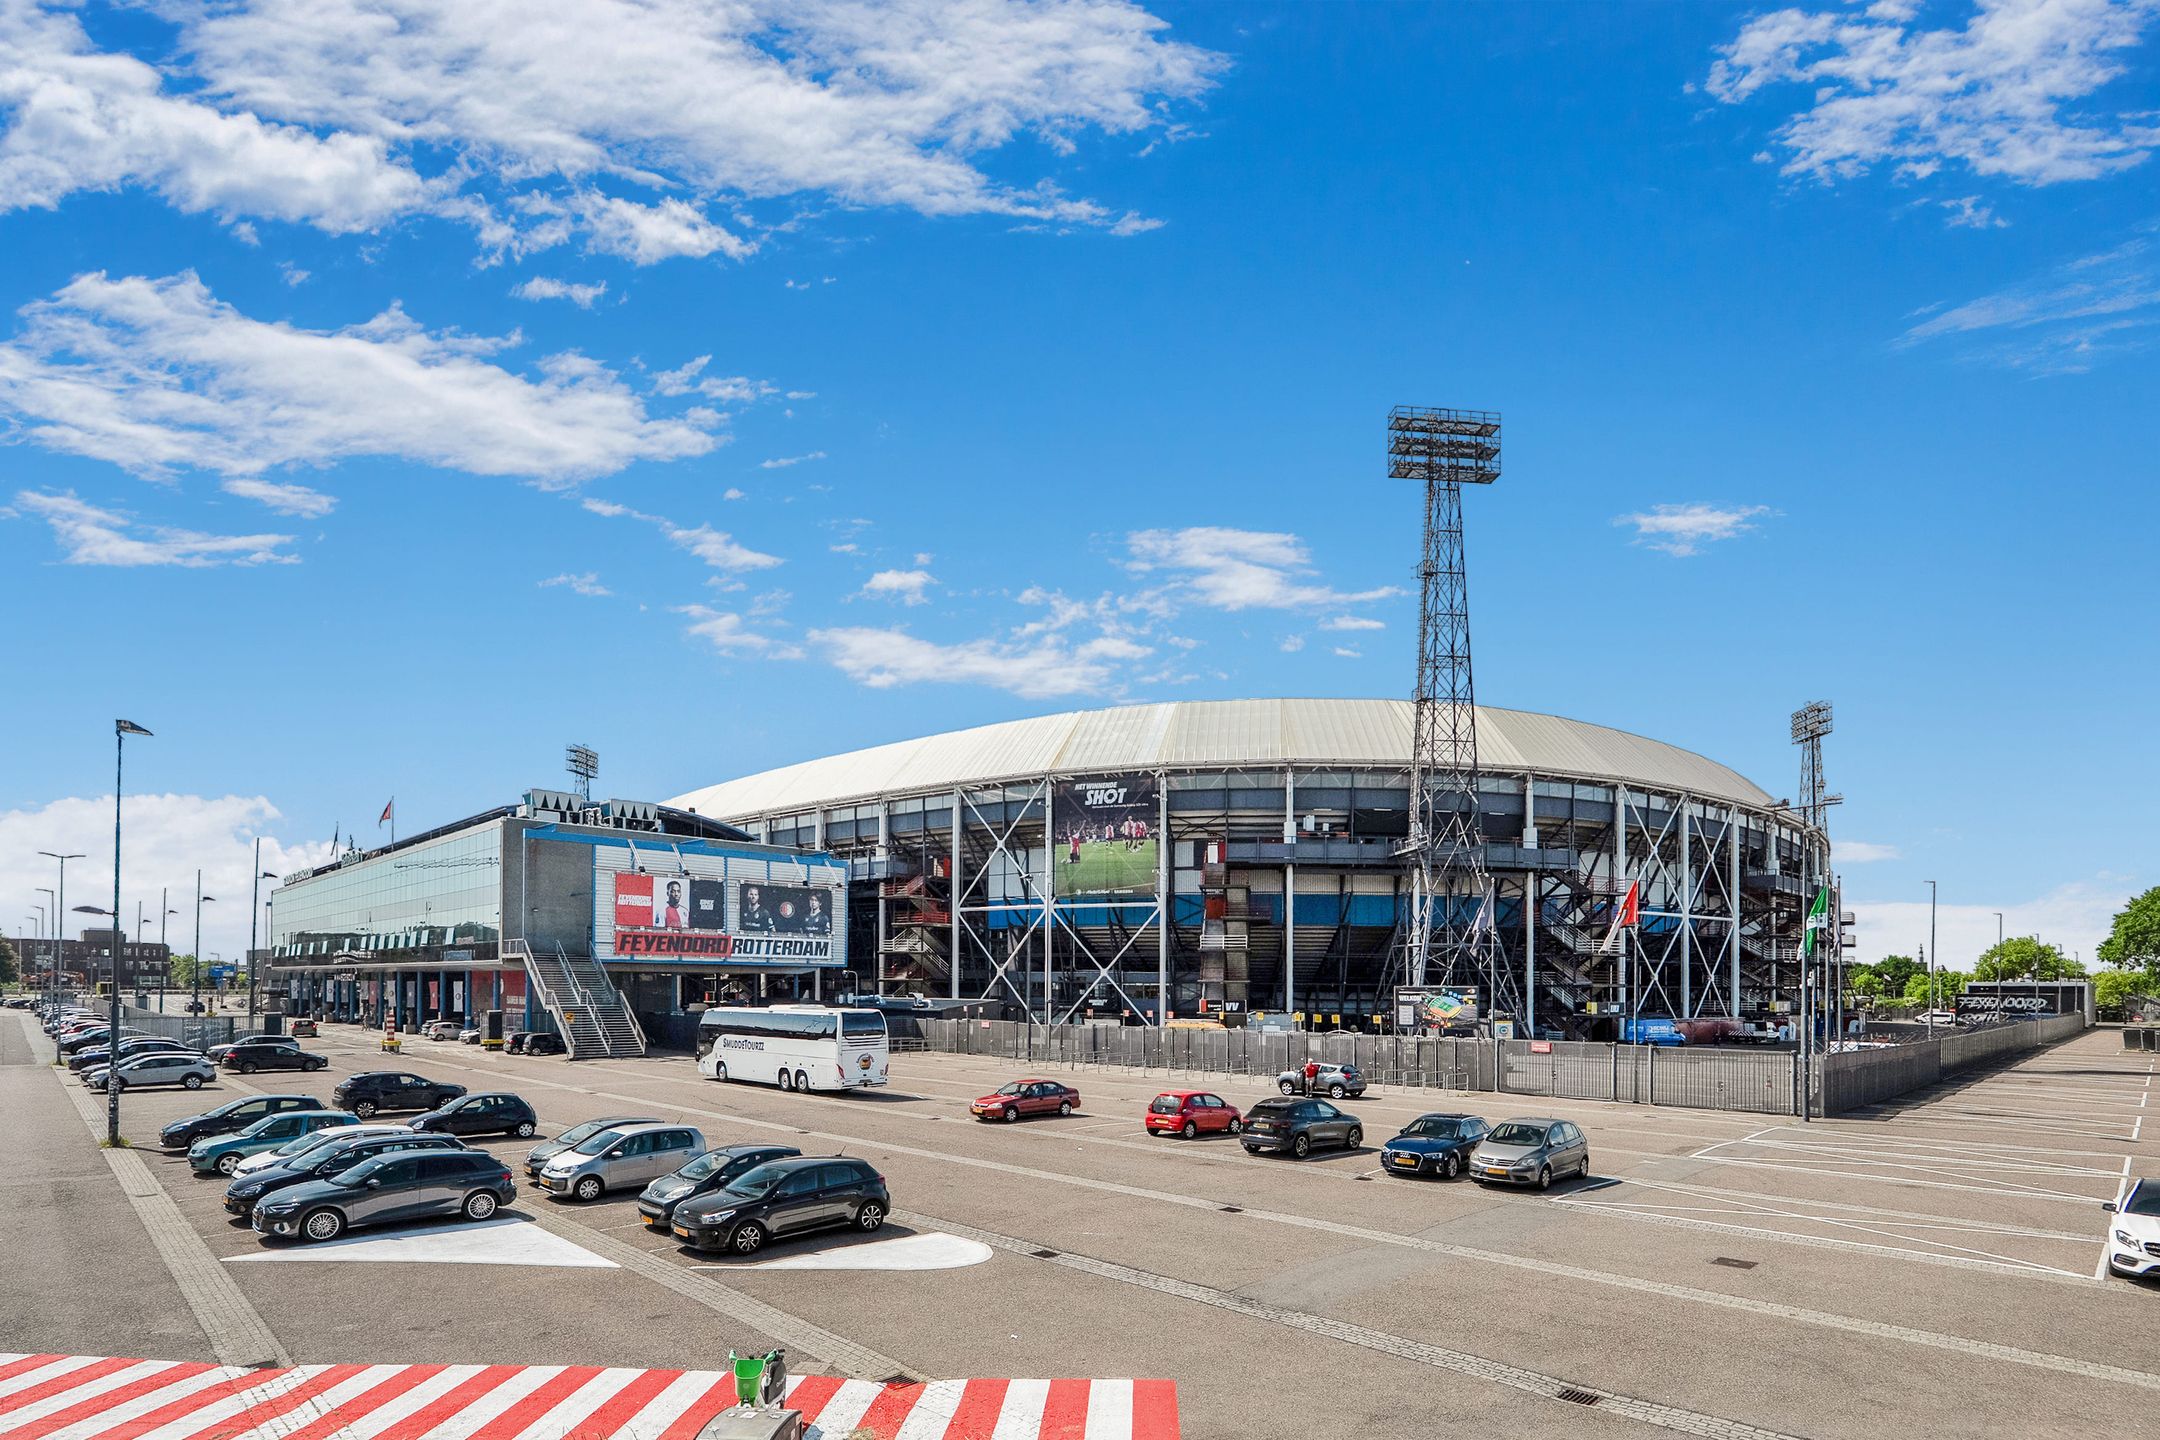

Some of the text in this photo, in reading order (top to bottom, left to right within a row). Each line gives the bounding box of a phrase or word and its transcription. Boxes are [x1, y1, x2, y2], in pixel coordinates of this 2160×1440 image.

[1085, 789, 1127, 805] SHOT
[619, 934, 830, 957] FEYENOORD ROTTERDAM
